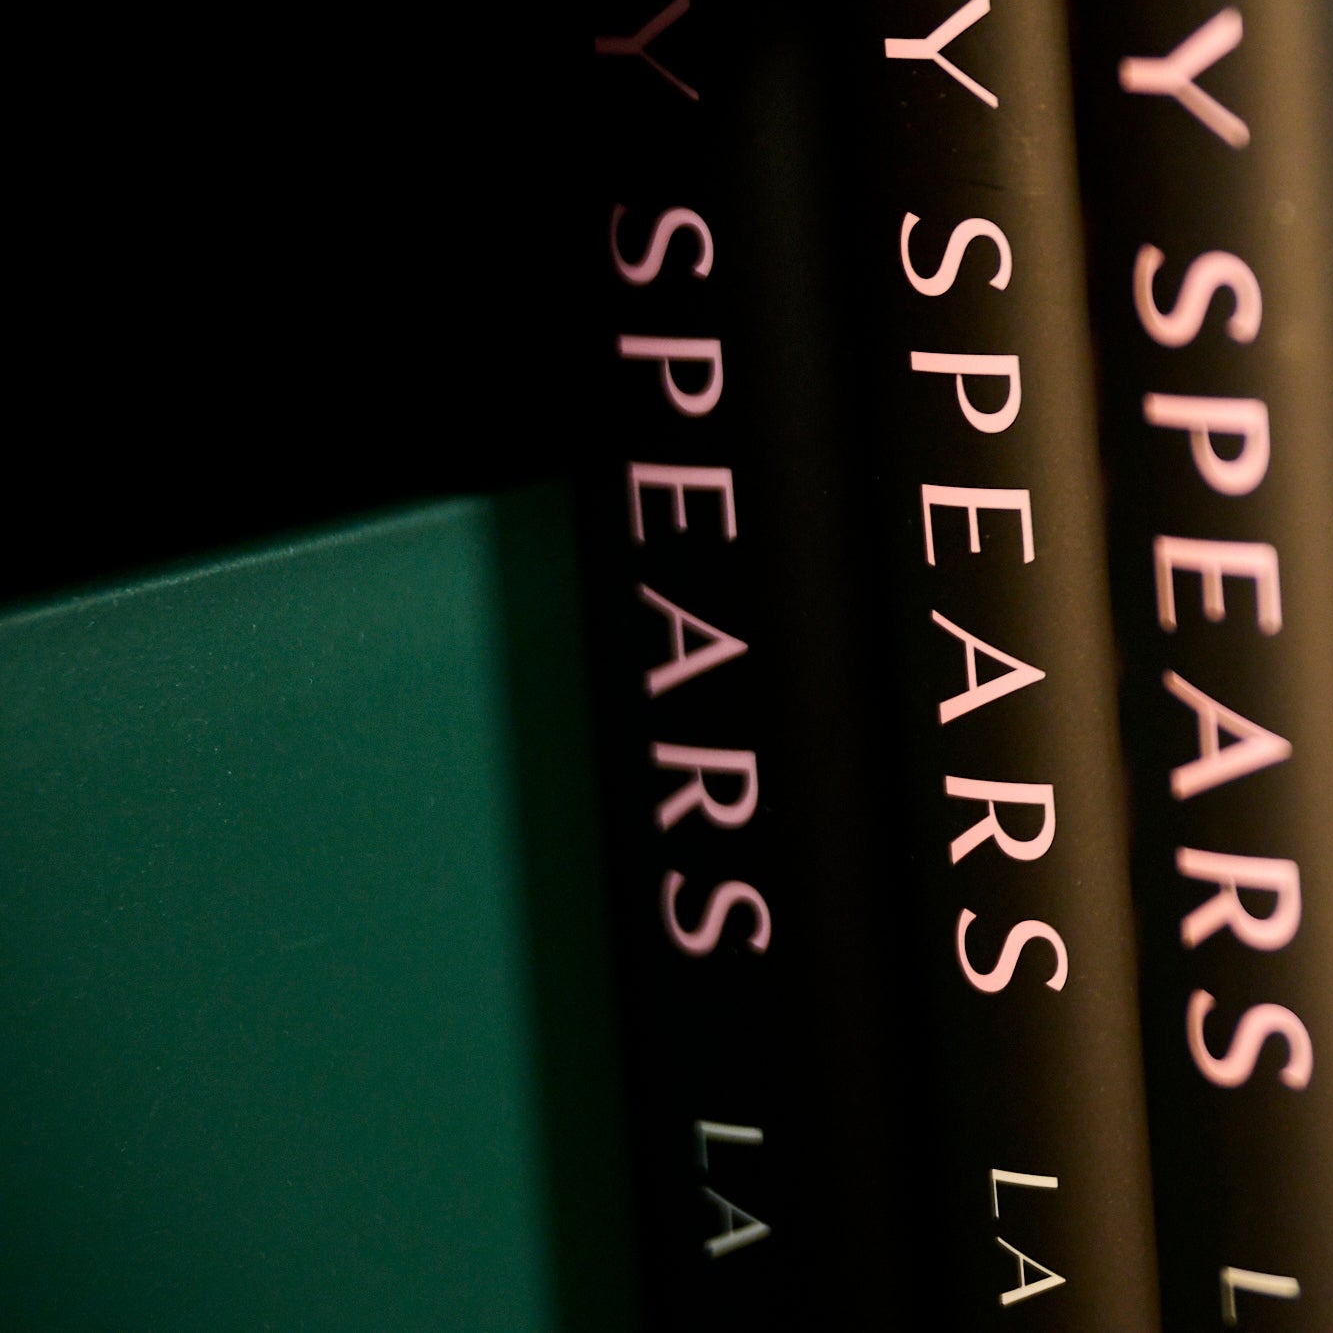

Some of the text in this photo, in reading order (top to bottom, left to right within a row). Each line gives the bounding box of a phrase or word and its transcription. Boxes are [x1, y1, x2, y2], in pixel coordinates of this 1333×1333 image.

[608, 202, 773, 959] SPEARS
[899, 210, 1069, 994] SPEARS
[1132, 241, 1315, 1091] SPEARS
[692, 1118, 772, 1260] LA
[990, 1167, 1067, 1307] LA
